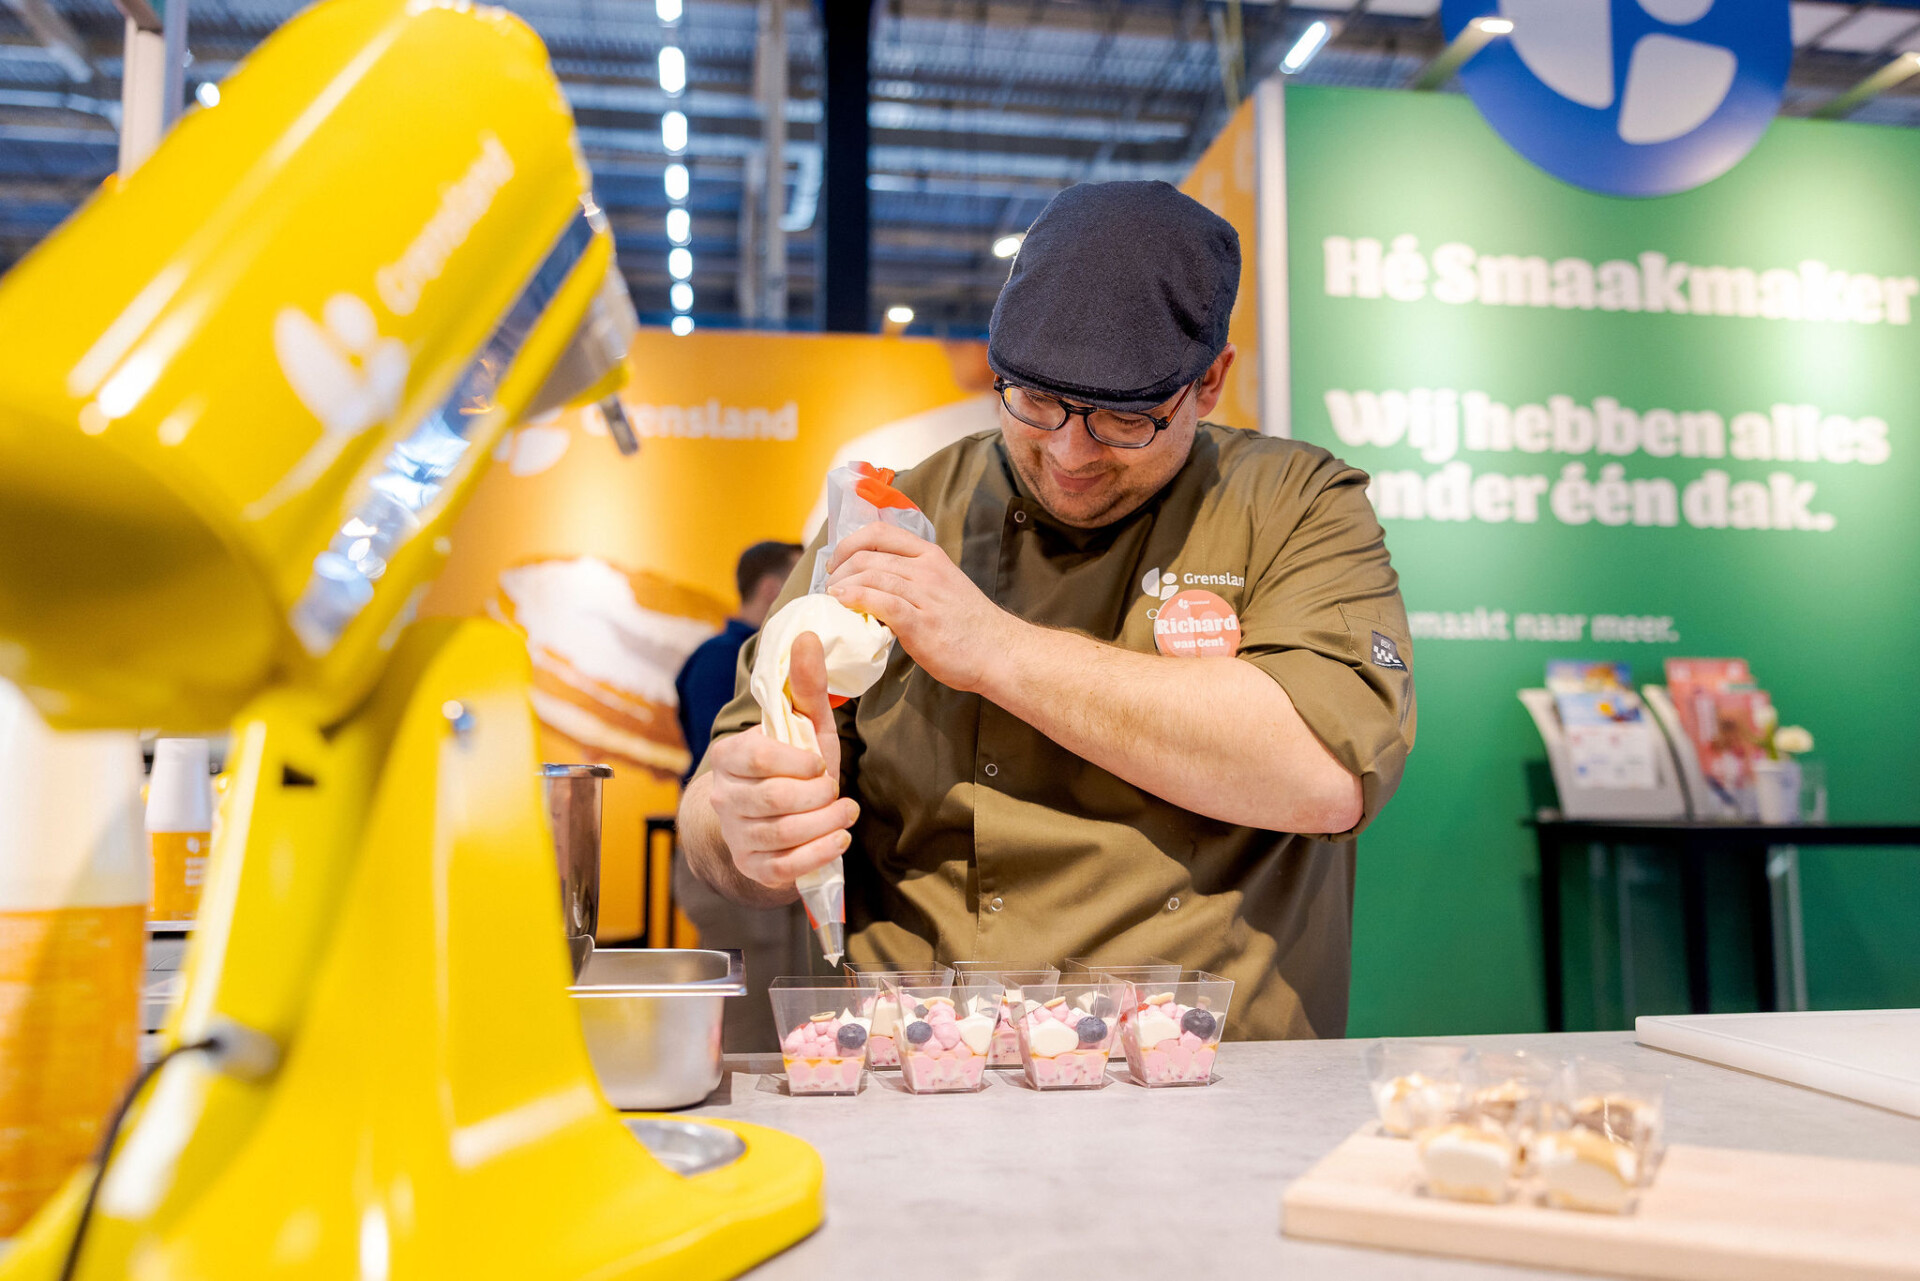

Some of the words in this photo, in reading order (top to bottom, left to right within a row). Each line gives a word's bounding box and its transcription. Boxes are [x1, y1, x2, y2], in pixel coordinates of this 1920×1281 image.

[1323, 234, 1429, 301] Hé
[1432, 243, 1919, 325] Smaakmaker
[581, 397, 798, 440] Gensland
[1462, 391, 1726, 459] hebben
[1730, 403, 1891, 465] alles
[1365, 461, 1548, 523] nder
[1551, 462, 1679, 526] één
[1682, 469, 1837, 532] dak.
[1156, 614, 1237, 634] Richard
[1173, 640, 1196, 648] van
[1197, 637, 1224, 647] Gent
[1515, 613, 1588, 641] naar
[1591, 614, 1680, 643] meer.
